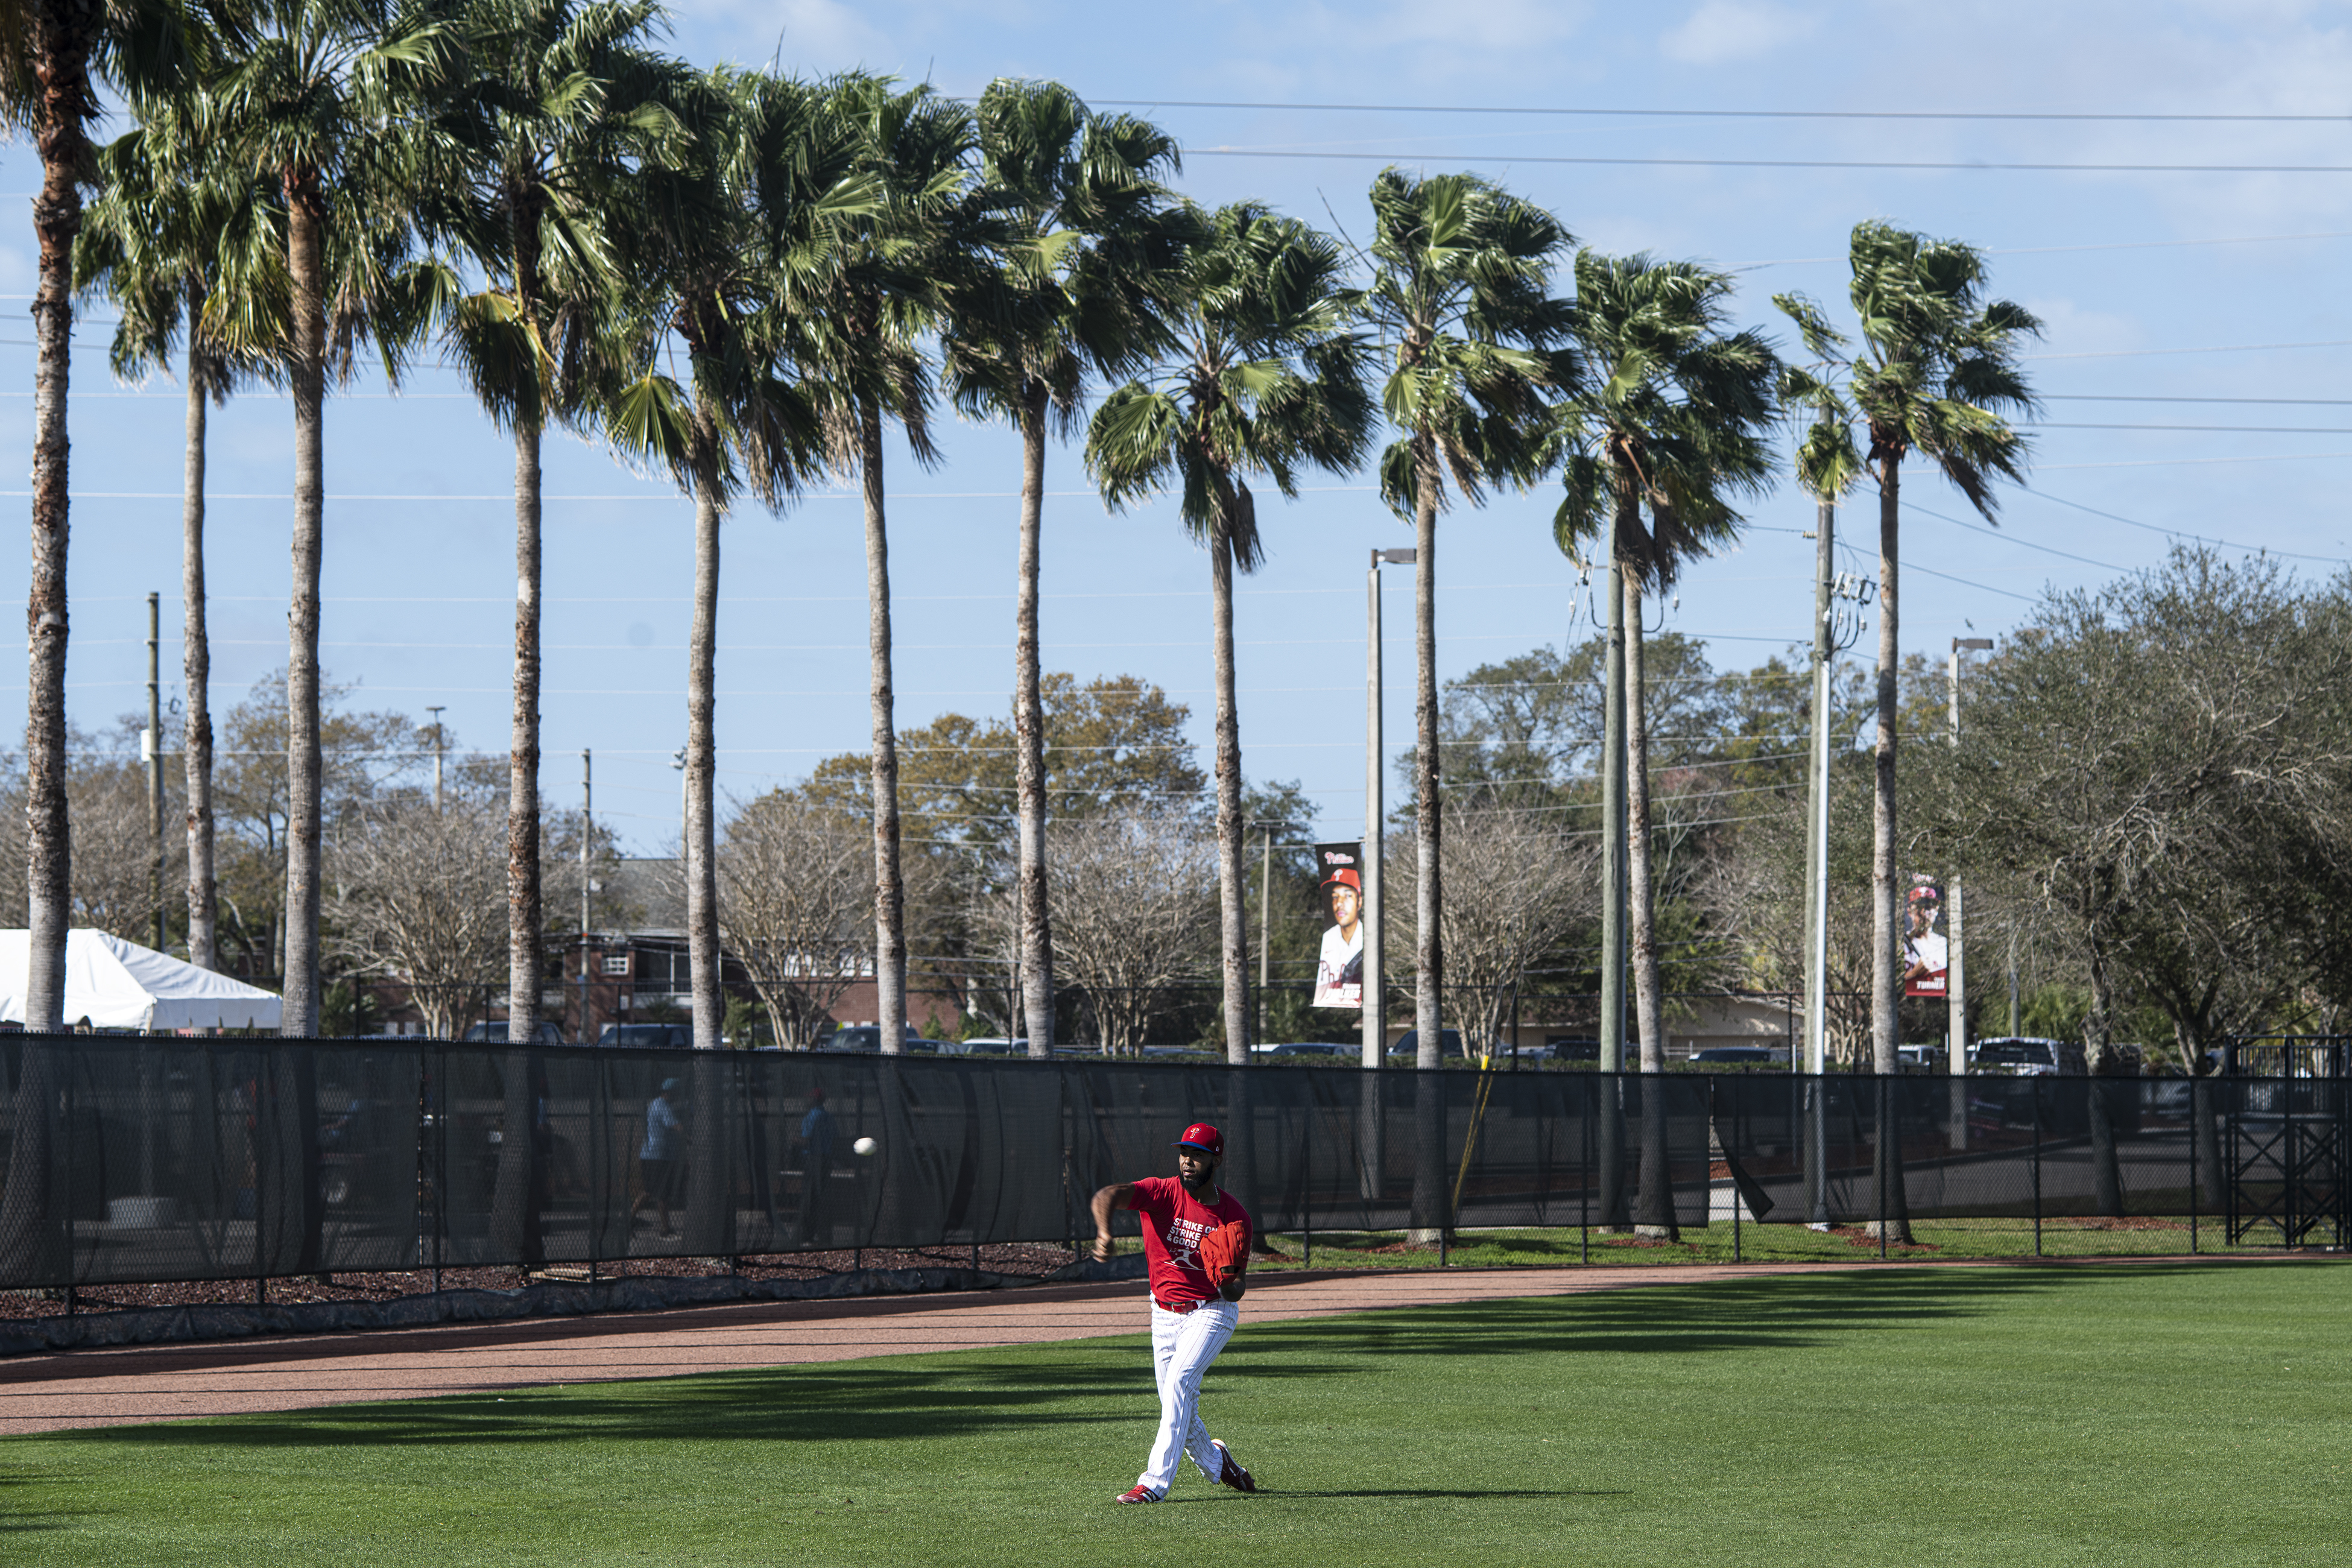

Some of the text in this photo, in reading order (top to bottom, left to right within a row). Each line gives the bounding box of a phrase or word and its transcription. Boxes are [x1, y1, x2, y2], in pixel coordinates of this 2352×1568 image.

[1916, 981, 1945, 990] TURNER
[1190, 1127, 1201, 1139] P
[1173, 1218, 1204, 1233] STRIKE
[1166, 1233, 1172, 1242] &
[1173, 1236, 1197, 1248] GOOD
[1170, 1226, 1201, 1241] STRIKE
